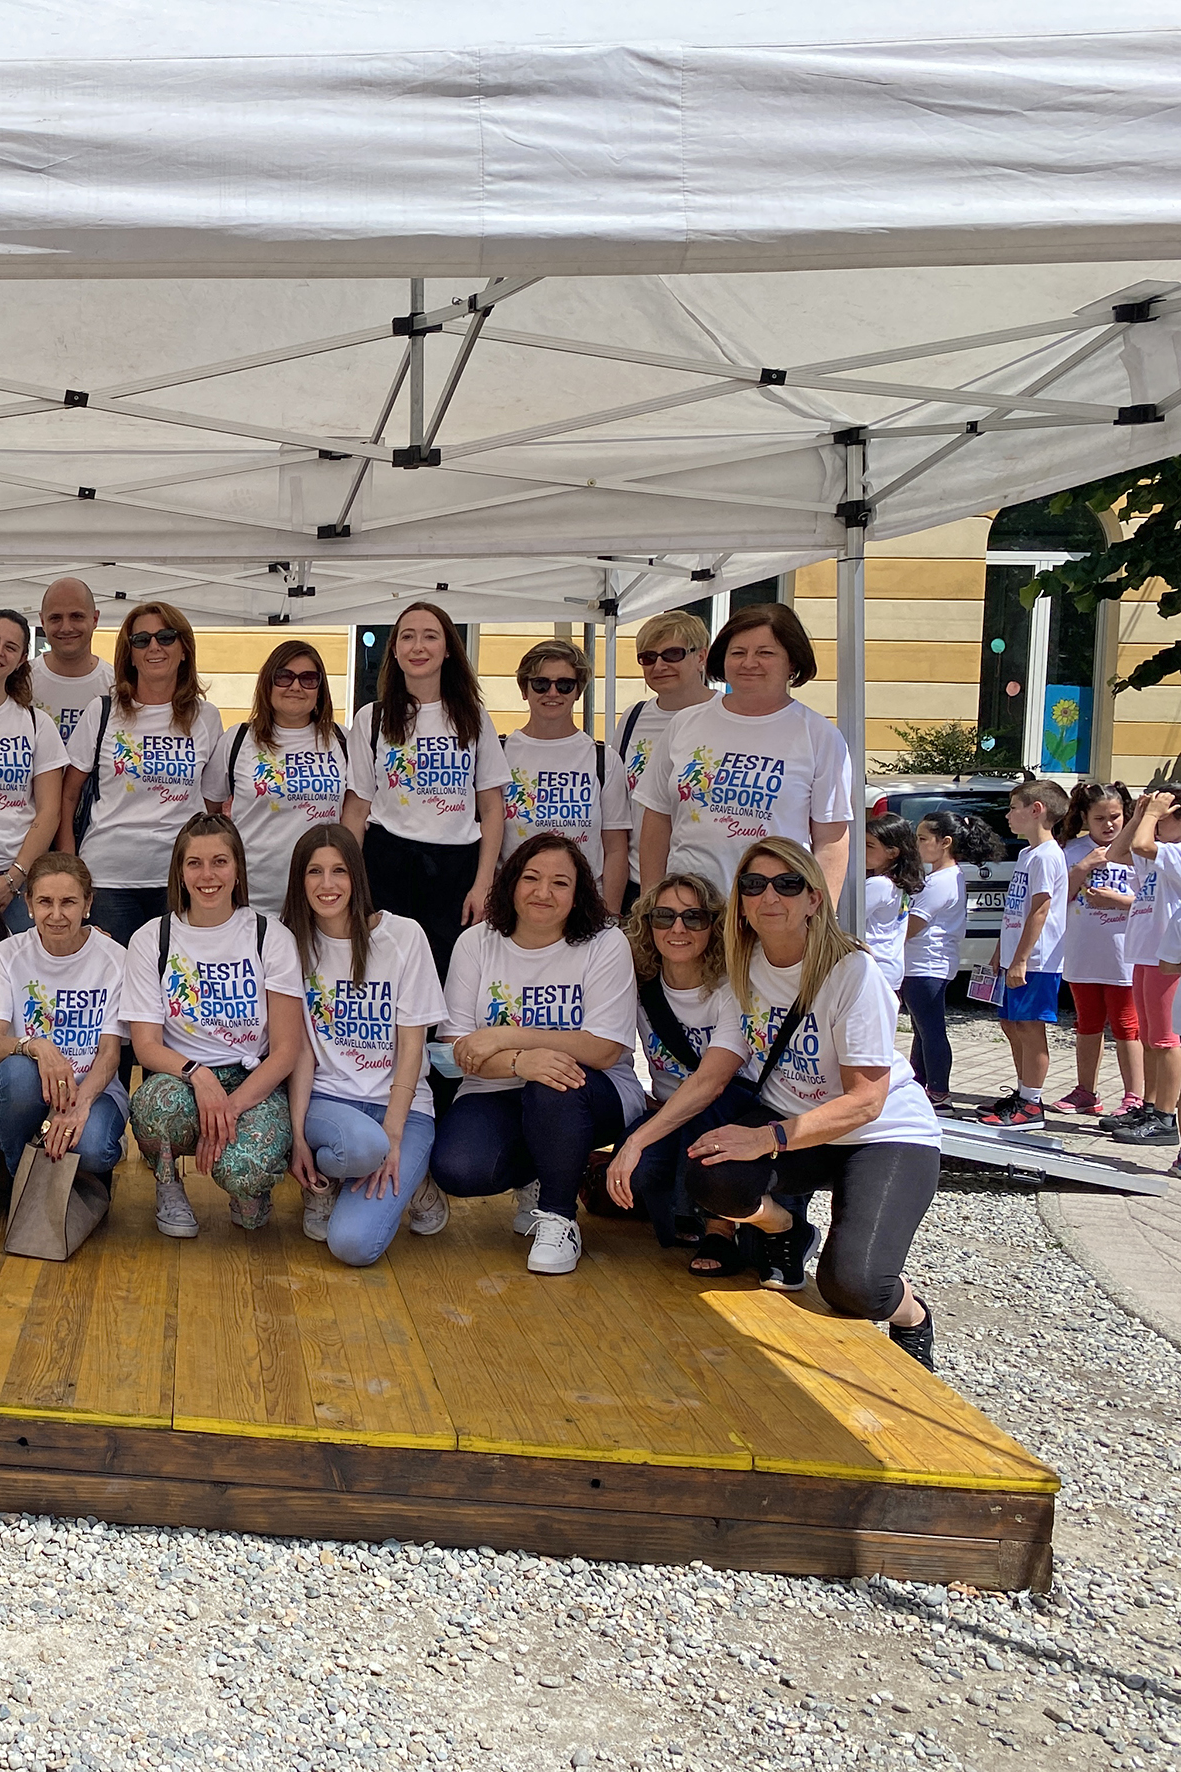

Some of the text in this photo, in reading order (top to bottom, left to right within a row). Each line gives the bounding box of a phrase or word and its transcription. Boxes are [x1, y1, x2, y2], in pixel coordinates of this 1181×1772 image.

[143, 736, 194, 750] FESTA
[417, 736, 470, 752] FEST
[144, 750, 195, 762] DELLO
[286, 751, 337, 765] FESTA
[418, 752, 471, 770] DELLO
[721, 753, 784, 775] FESTA
[143, 761, 196, 778] SPORT
[286, 765, 339, 778] DELLO
[142, 776, 181, 784] GRAVELLONA
[287, 779, 341, 793] SPORT
[417, 771, 469, 787] SPORT
[538, 771, 591, 787] FESTA
[714, 769, 782, 792] DELLO
[417, 787, 456, 795] GRAVELLONA
[537, 787, 591, 803] DELLO
[712, 787, 778, 811] SPORT
[306, 806, 335, 821] Scuola
[536, 804, 591, 819] SPORT
[710, 804, 773, 820] GRAVELLONA TOCE
[727, 822, 767, 838] Scuola
[197, 959, 255, 981] FESTA
[200, 979, 256, 1000] DELLO
[336, 980, 391, 1000] FESTA
[523, 984, 582, 1005] FESTA
[56, 989, 107, 1008] FESTA
[201, 1000, 257, 1019] SPORT
[334, 1000, 391, 1021] DELLO
[522, 1005, 582, 1026] DELLO
[54, 1008, 103, 1028] DELLO
[201, 1018, 259, 1028] GRAVELLONA TOCE
[53, 1028, 101, 1046] SPORT
[224, 1031, 258, 1046] Scuola
[335, 1021, 392, 1040] SPORT
[335, 1037, 393, 1050] GRAVELLONA TOCE
[355, 1054, 392, 1071] Scuola
[779, 1049, 820, 1075] PORT
[807, 1075, 826, 1084] TOCE
